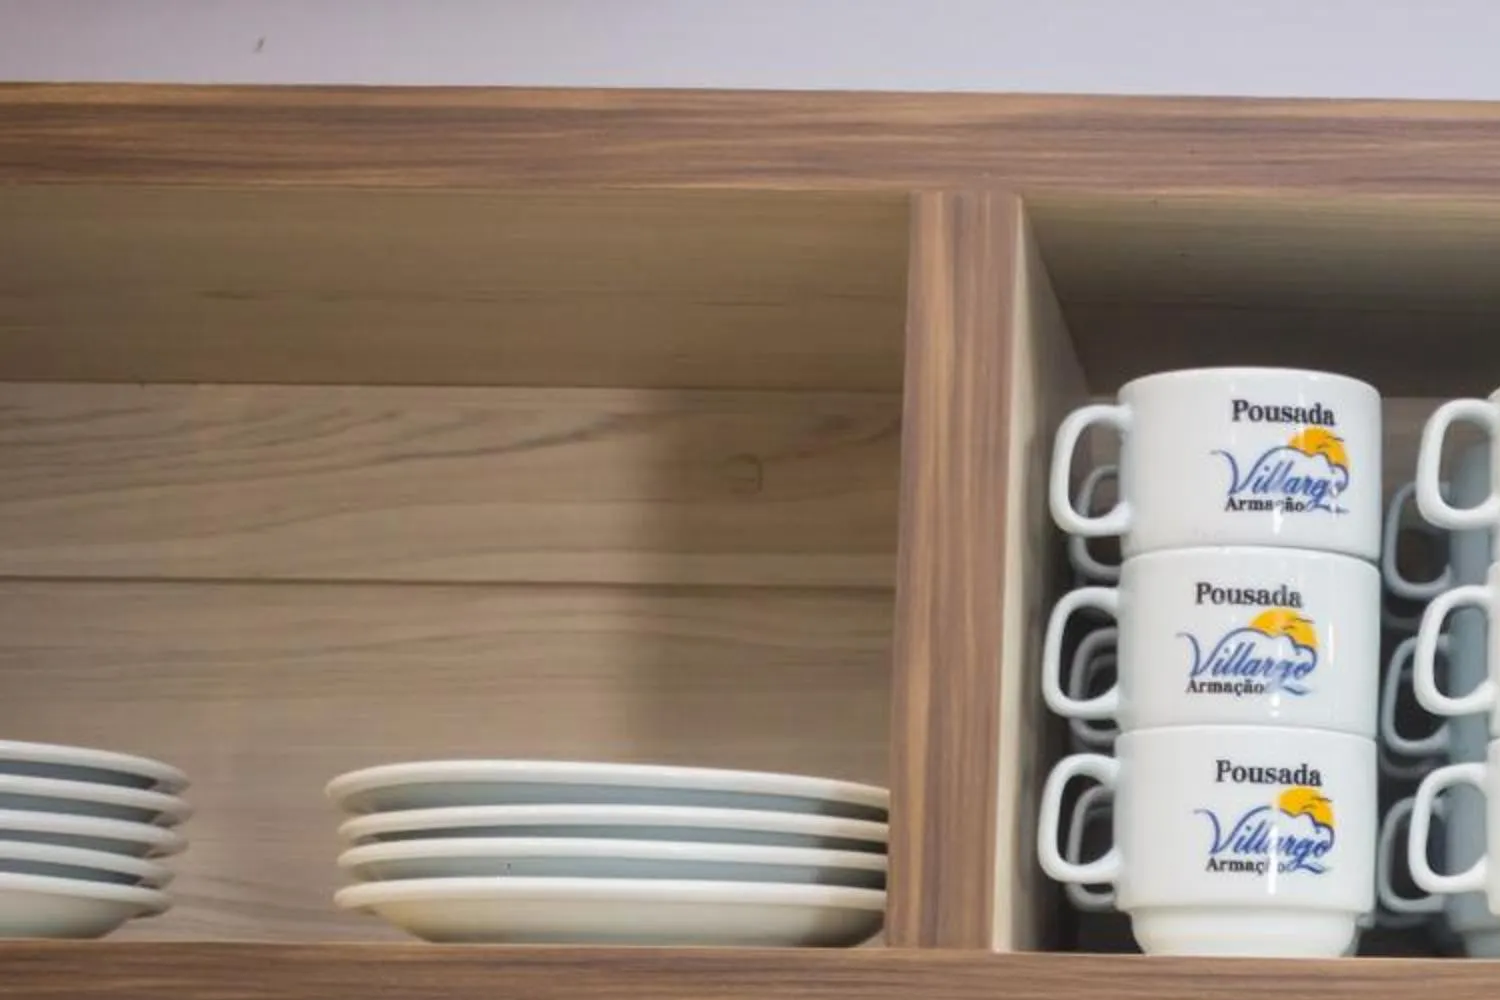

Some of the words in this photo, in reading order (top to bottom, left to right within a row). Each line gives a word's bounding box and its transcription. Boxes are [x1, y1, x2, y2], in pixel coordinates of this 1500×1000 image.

[1231, 399, 1336, 428] Pousada
[1195, 581, 1303, 609] Pousada
[1186, 679, 1265, 695] Armação
[1215, 759, 1323, 788] Pousada
[1206, 858, 1290, 875] Armaço
